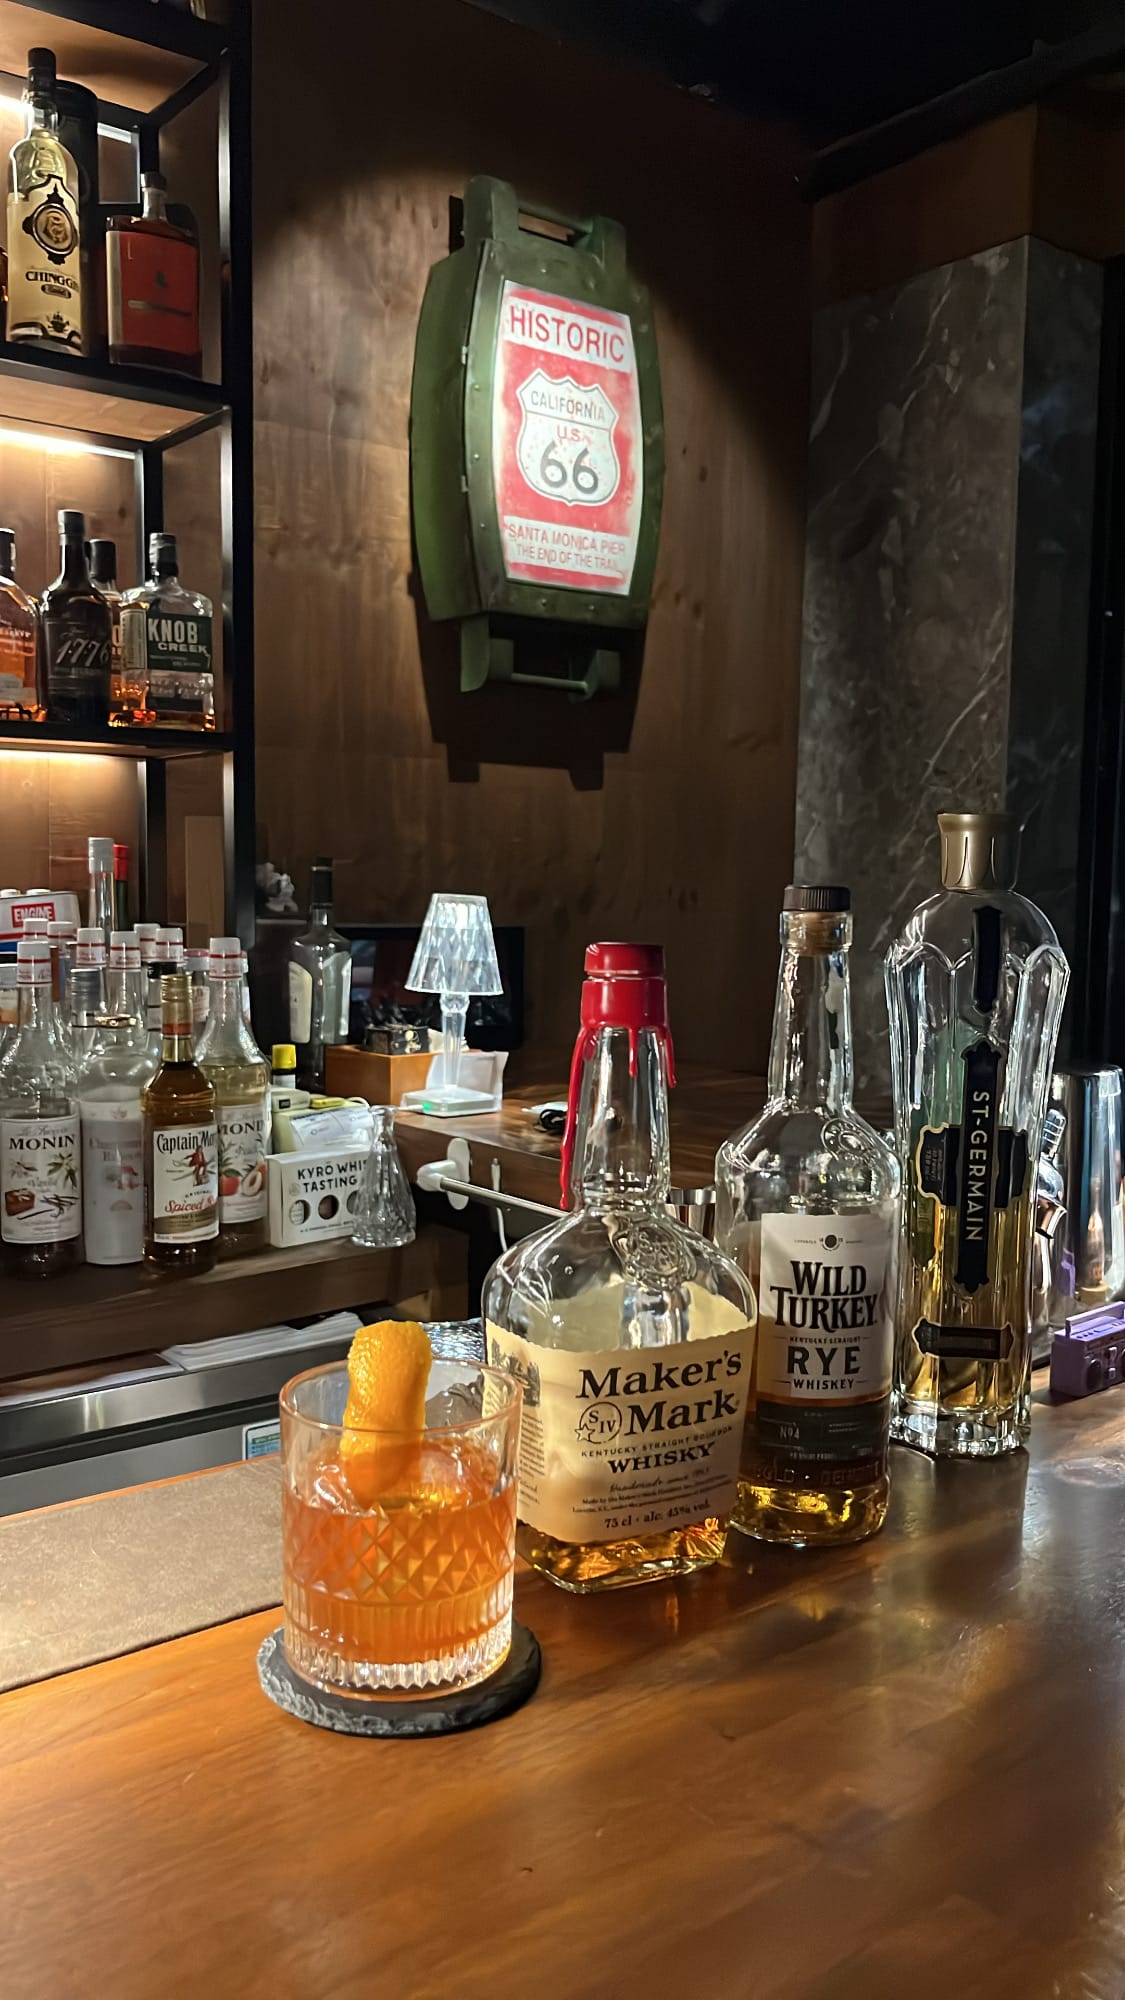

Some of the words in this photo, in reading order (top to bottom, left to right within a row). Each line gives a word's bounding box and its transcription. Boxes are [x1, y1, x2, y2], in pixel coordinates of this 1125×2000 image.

[509, 305, 625, 363] HISTORIC
[530, 390, 606, 423] CALIFORNIA
[540, 440, 599, 494] 66
[508, 523, 549, 544] SANTA
[552, 530, 598, 552] MONICA
[517, 543, 535, 560] THE
[537, 547, 557, 564] END
[559, 551, 573, 564] OF
[574, 553, 593, 568] THE
[147, 617, 198, 644] KNOB
[157, 642, 209, 656] CREEK
[13, 904, 54, 922] ENGINE
[9, 1134, 75, 1151] MONIN
[156, 1132, 199, 1154] Captain
[966, 1090, 990, 1241] ST-GERMAIN
[303, 1175, 358, 1193] TASTING
[165, 1198, 204, 1213] Spiced
[790, 1260, 867, 1297] WILD
[769, 1285, 878, 1333] TURKEY
[575, 1350, 742, 1399] Maker's
[787, 1346, 861, 1376] RYE
[793, 1378, 855, 1391] WHISKEY
[624, 1389, 738, 1436] Mark
[581, 1446, 636, 1458] KENTUCKY
[641, 1436, 689, 1452] STRAIGHT
[608, 1441, 716, 1474] WHISKY
[604, 1517, 619, 1529] 75
[621, 1514, 632, 1527] cl
